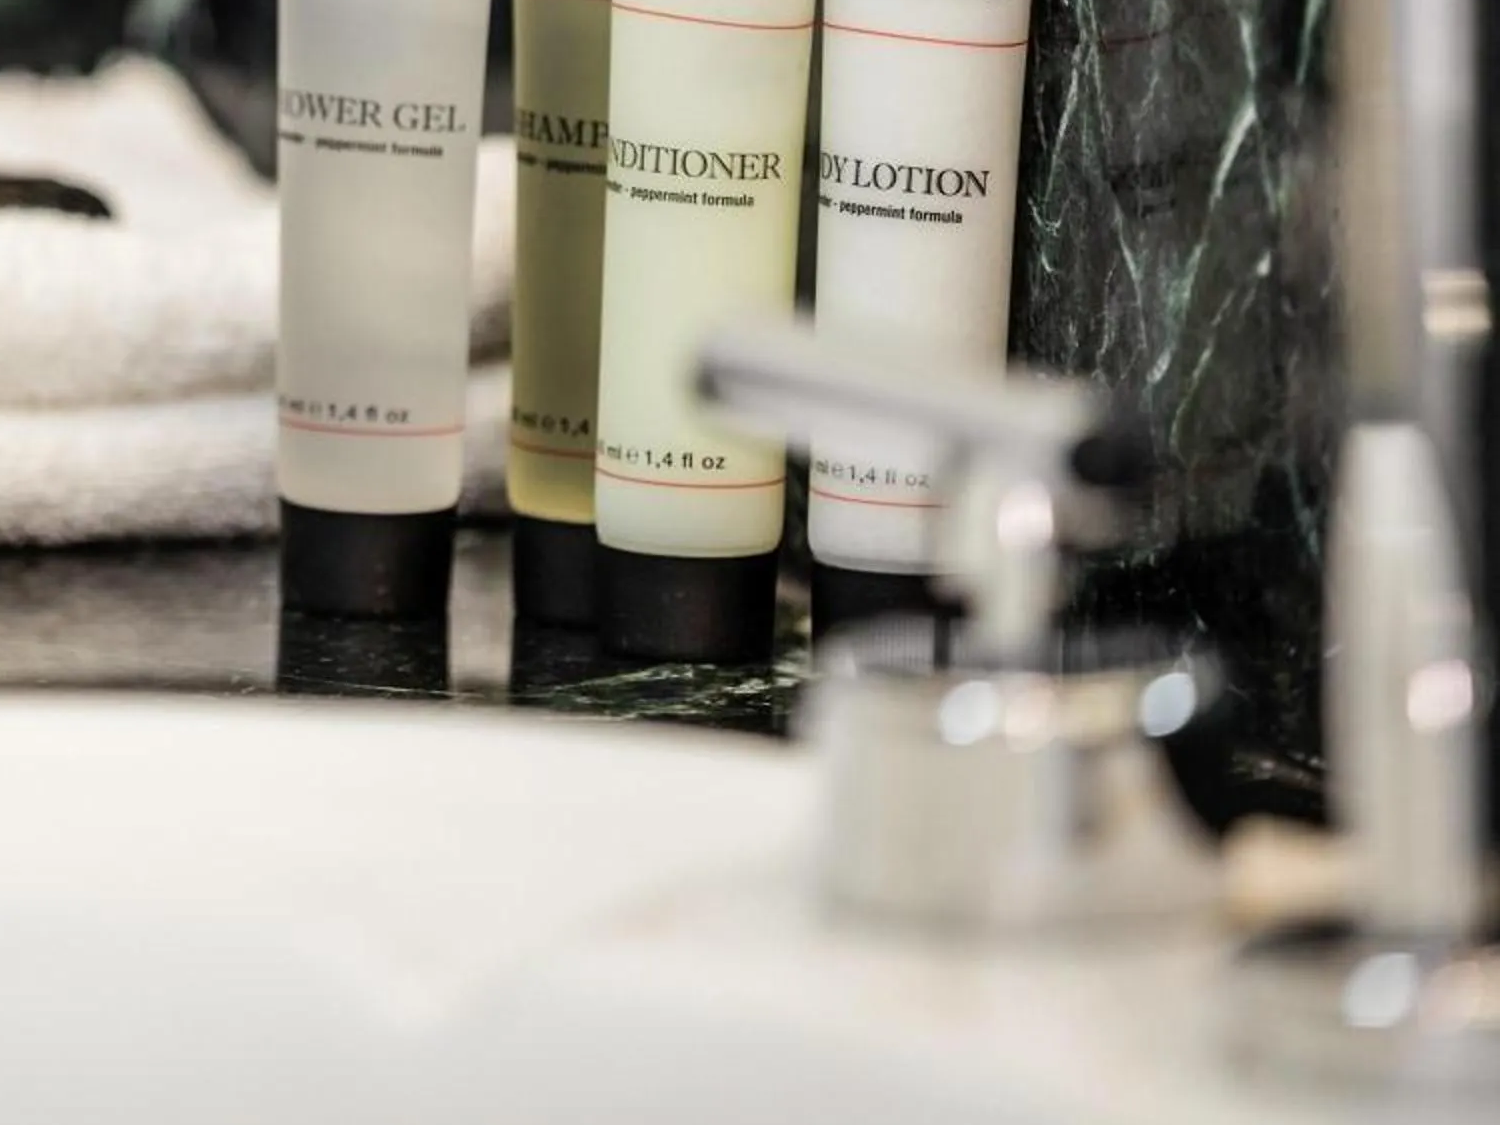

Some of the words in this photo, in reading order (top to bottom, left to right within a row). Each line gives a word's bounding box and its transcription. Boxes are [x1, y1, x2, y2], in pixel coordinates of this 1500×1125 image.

[393, 102, 467, 134] GEL
[391, 142, 444, 157] formula
[851, 158, 990, 197] LOTION
[630, 186, 698, 206] peppermint
[701, 191, 755, 207] formula
[839, 200, 905, 220] peppermint
[909, 206, 963, 224] formula
[646, 449, 674, 470] 1,4
[682, 453, 693, 469] fl
[701, 457, 725, 471] oz
[850, 465, 875, 484] 1,4
